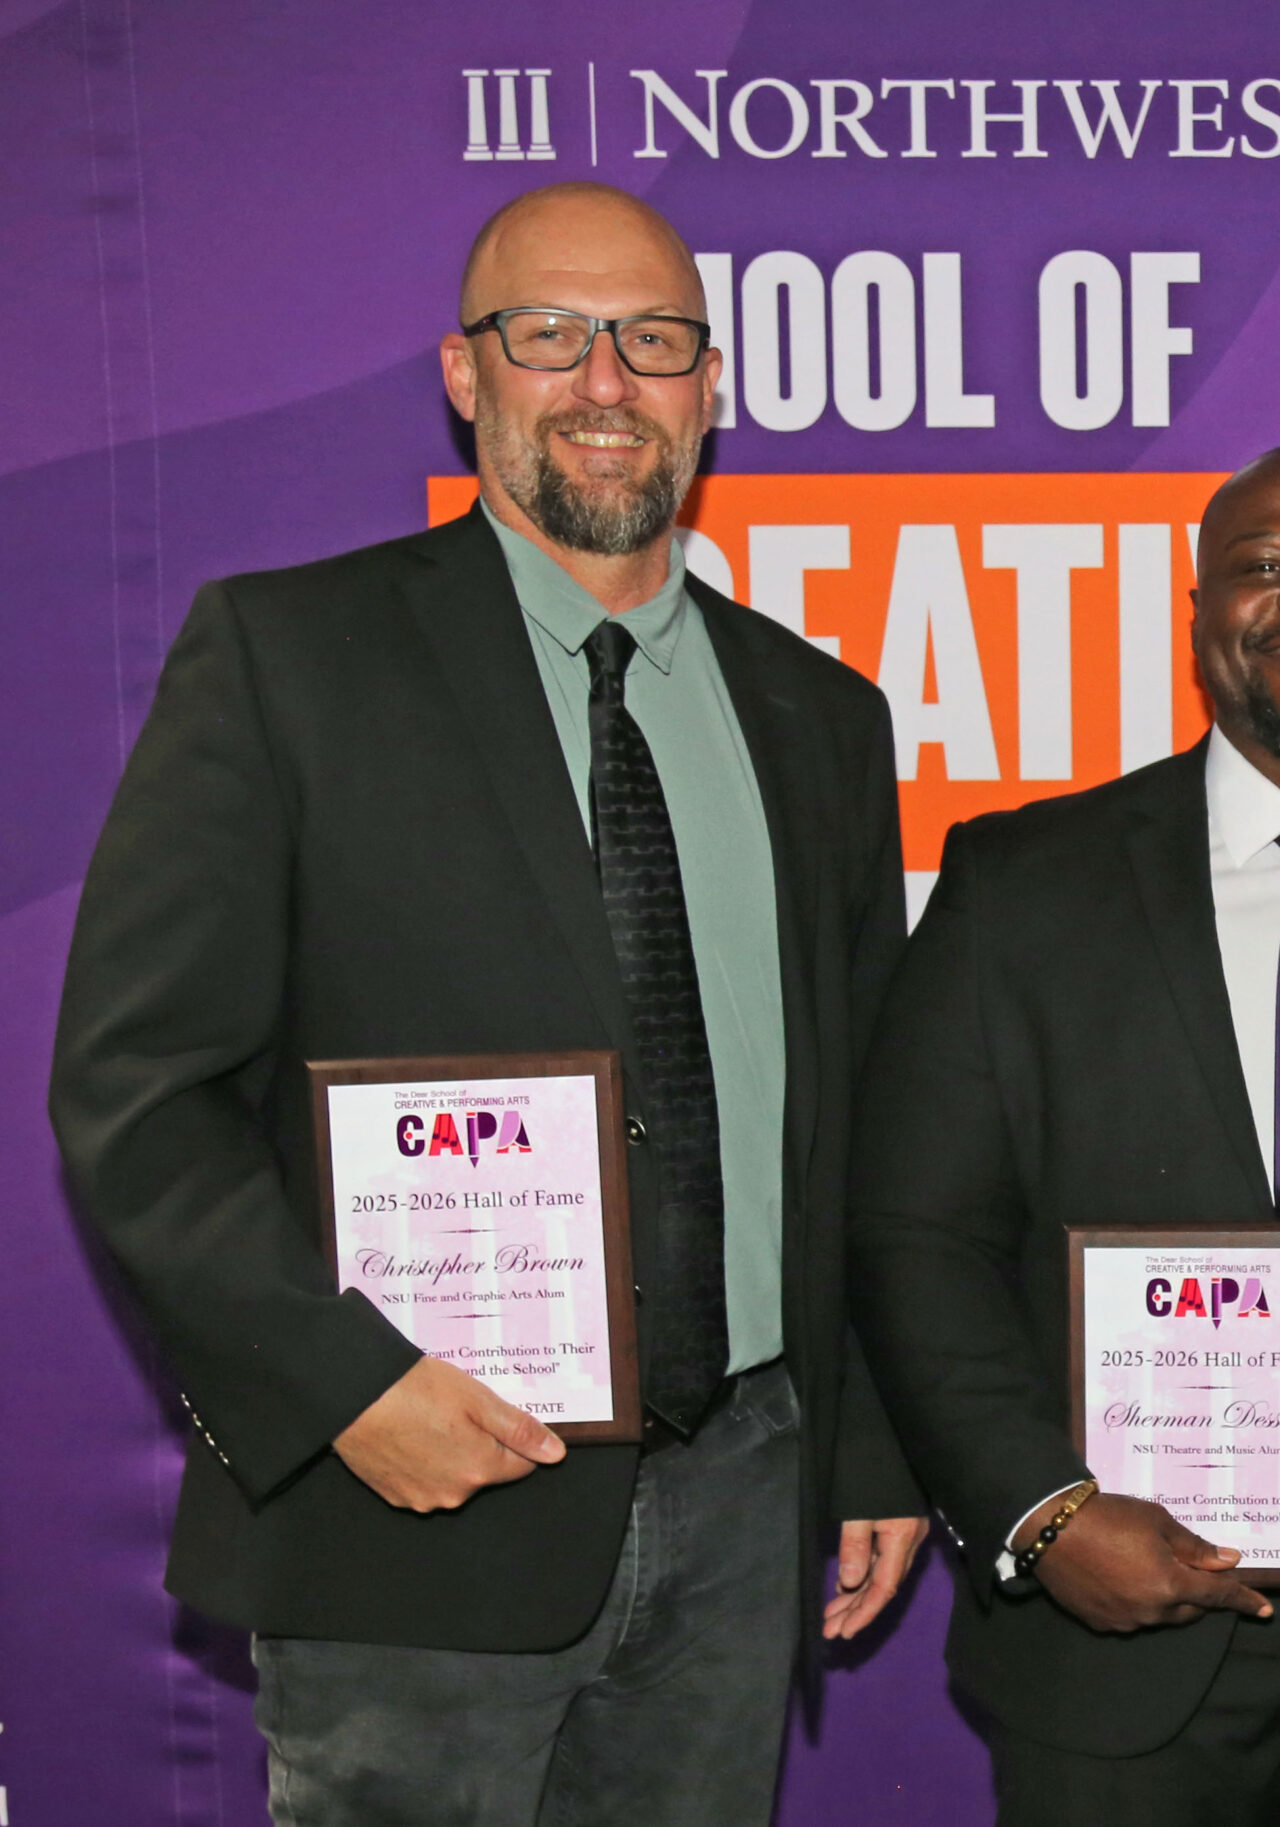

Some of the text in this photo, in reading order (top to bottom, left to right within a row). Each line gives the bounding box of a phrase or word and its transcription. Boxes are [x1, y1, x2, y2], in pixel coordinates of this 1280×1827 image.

[694, 250, 1201, 431] OOL OF
[431, 1090, 457, 1098] School
[459, 1089, 467, 1097] of
[394, 1096, 531, 1109] CREATIVE & PERFORMING ARTS
[397, 1111, 532, 1168] CAPA
[352, 1189, 584, 1213] 2025-2026 Hall of Fame
[355, 1244, 586, 1286] Christopher Brown
[1145, 1265, 1271, 1273] CREATIVE & PERFORMING ARTS
[381, 1289, 565, 1304] NSU Fine and Graphic Arts Alum
[1146, 1277, 1271, 1330] CAPA
[459, 1345, 541, 1358] Contribution
[543, 1345, 556, 1355] to
[559, 1343, 596, 1355] Their
[1101, 1350, 1199, 1367] 2025-2026
[1204, 1352, 1242, 1367] Hall
[1247, 1351, 1266, 1367] of
[489, 1364, 510, 1375] the
[512, 1362, 561, 1375] School"
[525, 1403, 565, 1413] STATE
[1103, 1400, 1214, 1433] Sherman
[1132, 1444, 1160, 1454] NSU
[1163, 1444, 1202, 1454] Theatre
[1205, 1445, 1223, 1455] and
[1225, 1445, 1256, 1455] Music
[1193, 1494, 1269, 1505] Contribution
[1196, 1512, 1217, 1522] and
[1220, 1512, 1239, 1522] the
